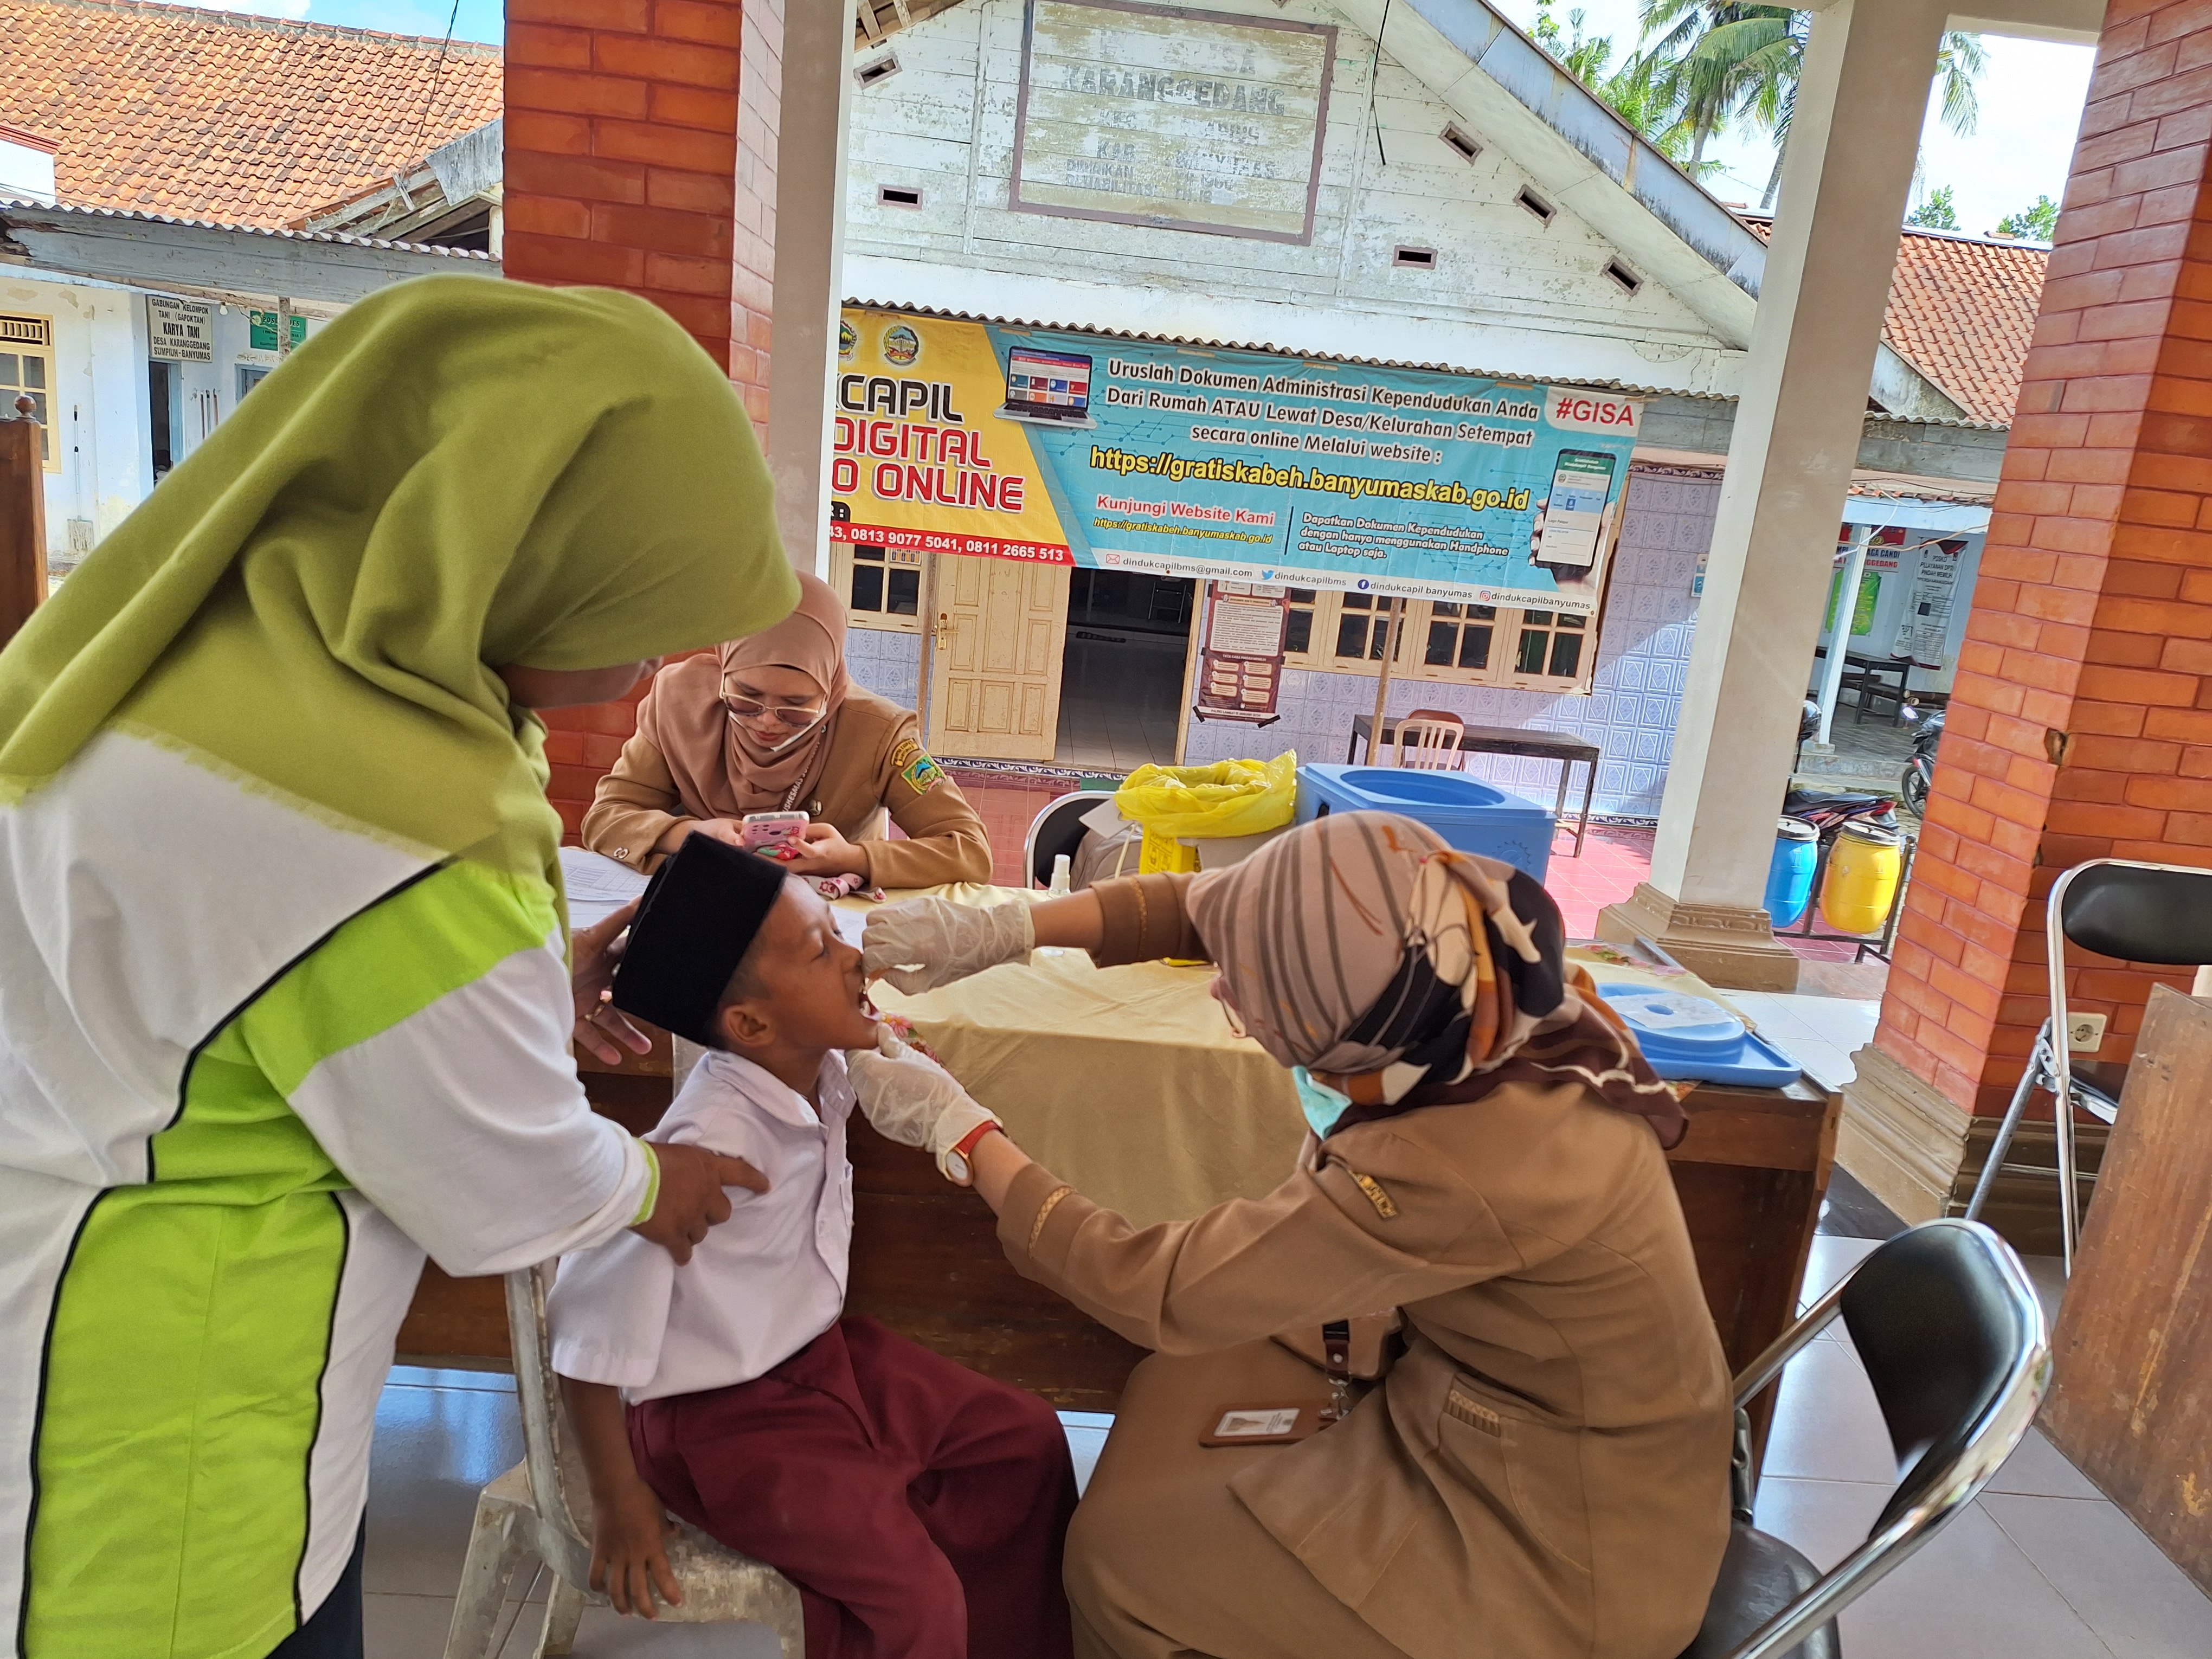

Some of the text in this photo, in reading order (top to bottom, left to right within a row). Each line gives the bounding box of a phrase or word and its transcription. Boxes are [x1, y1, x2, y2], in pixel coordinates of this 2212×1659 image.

[152, 298, 209, 314] GABUNGAN KELOMPOK
[158, 310, 205, 325] TANI (GAPOKTAN)
[153, 336, 210, 350] DESA KARANGGEDANG
[163, 321, 200, 339] KARYA TANI
[835, 373, 963, 422] CAPIL
[1109, 360, 1174, 382] Uruslah
[1180, 368, 1258, 390] Dokumen
[1262, 377, 1366, 402] Administrasi
[1372, 388, 1491, 414] Kependudukan
[1496, 401, 1539, 419] Anda
[1107, 388, 1533, 447] Dari Rumah ATAU Lewat Desa/Kelurahan Setempat
[1556, 397, 1634, 426] #GISA
[834, 417, 991, 468] DIGITAL
[1192, 427, 1246, 443] secara
[1250, 432, 1300, 448] online
[1304, 436, 1366, 455] Melalui
[1371, 444, 1430, 461] website
[876, 463, 1024, 511] ONLINE
[1090, 446, 1530, 511] https://gratiskabeh.banyumaskab.go.id
[1097, 496, 1274, 525] Kunjungi Website Kami
[1094, 517, 1273, 544] https://gratiskabeh.banyumaskab.go.id
[1303, 513, 1484, 540] Dapatkan Dokumen Kependudukan
[851, 528, 884, 543] 0813
[888, 532, 922, 546] 9077
[925, 536, 962, 553] 5041,
[966, 542, 999, 555] 0811
[1002, 544, 1036, 558] 2665
[1039, 548, 1064, 561] 513
[1298, 542, 1387, 560] atau Laptop saja.
[1300, 528, 1509, 556] dengan hanya menggunakan Handphone
[1123, 557, 1591, 610] dindukcapilbms@gmail.com dindukcapilbms dindukcapil banyumas dindukcapilbanyumas
